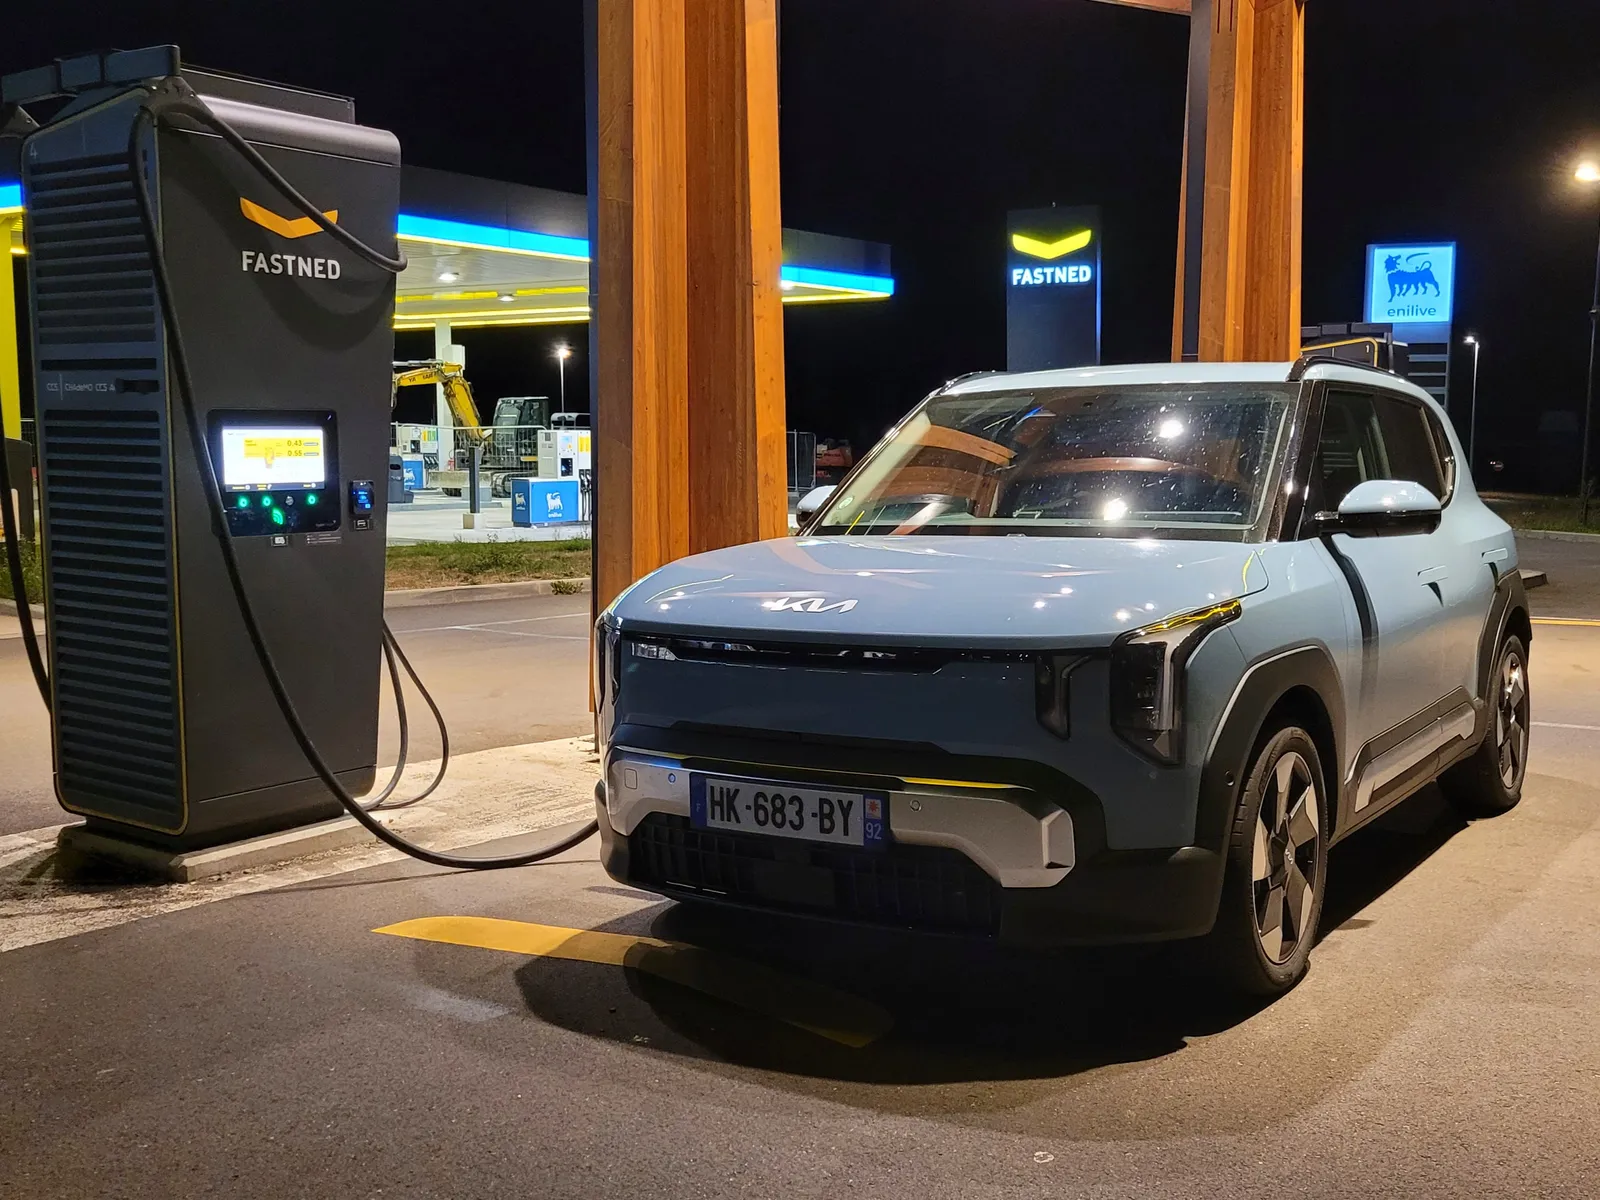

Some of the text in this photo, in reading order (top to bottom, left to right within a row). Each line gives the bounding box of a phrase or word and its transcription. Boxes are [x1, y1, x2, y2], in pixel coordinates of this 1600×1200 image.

[242, 250, 340, 280] FASTNED
[1012, 265, 1092, 285] FASTNED
[1387, 304, 1437, 317] enilive
[1365, 344, 1370, 354] 1
[770, 597, 858, 614] KIA
[709, 785, 853, 837] HK-683-BY
[866, 822, 882, 840] 92
